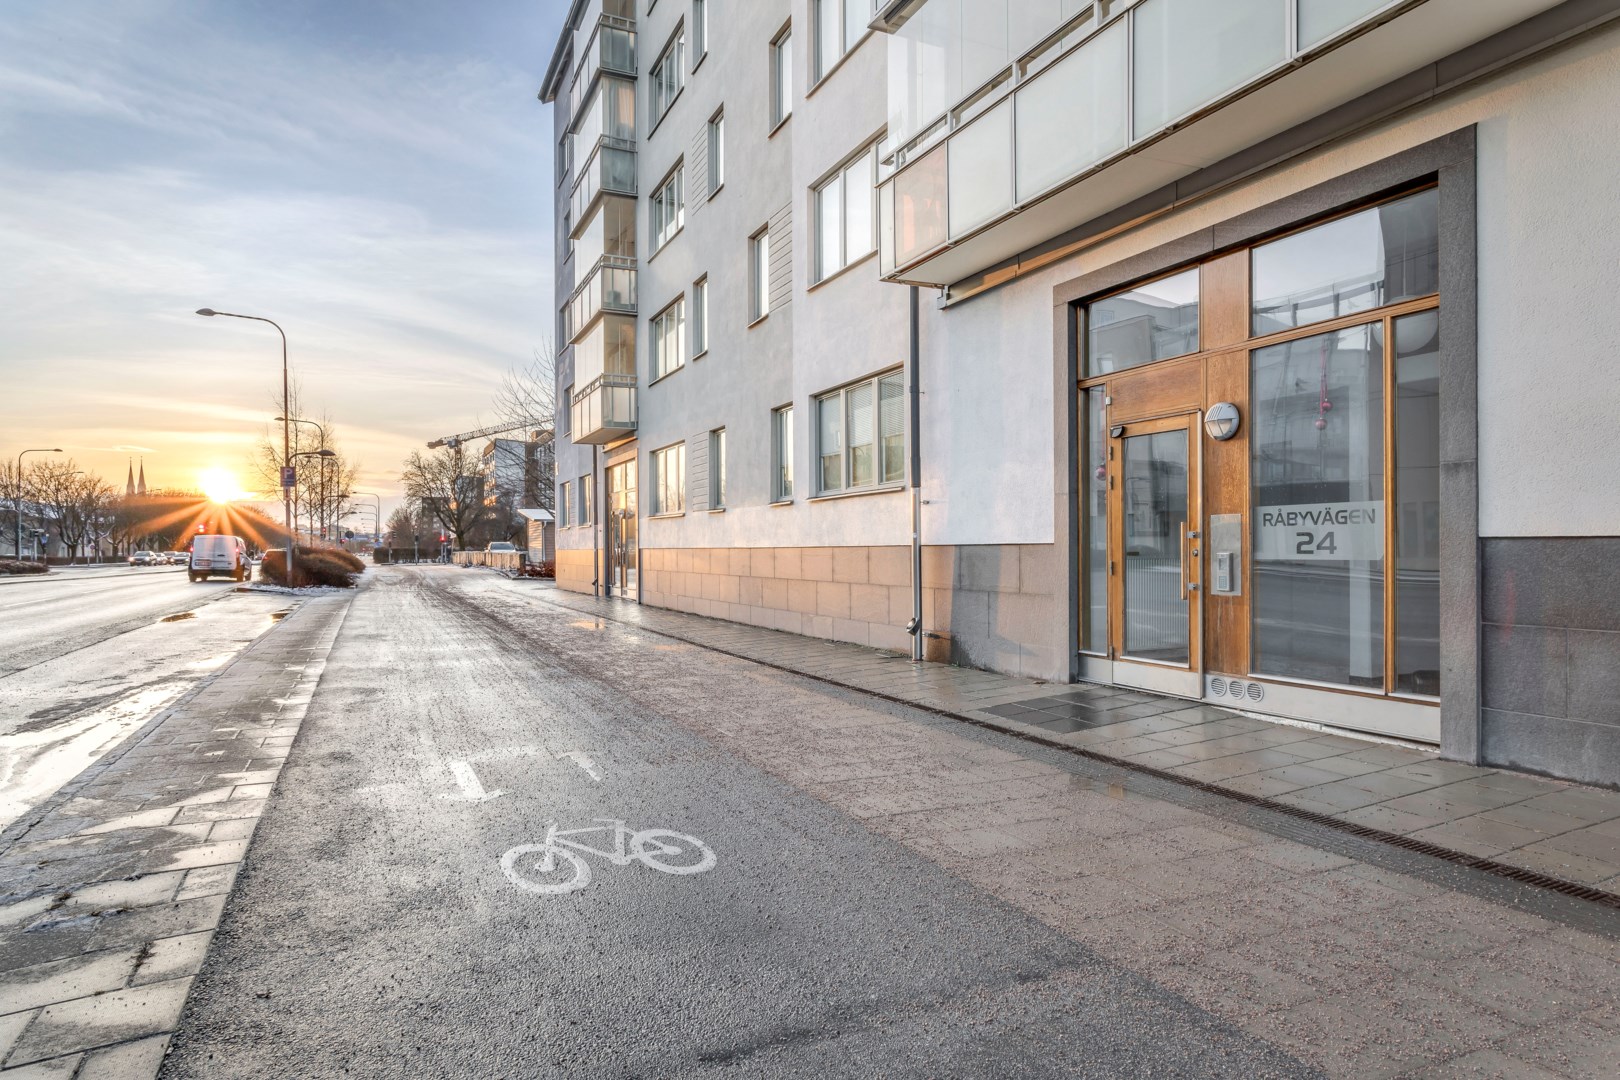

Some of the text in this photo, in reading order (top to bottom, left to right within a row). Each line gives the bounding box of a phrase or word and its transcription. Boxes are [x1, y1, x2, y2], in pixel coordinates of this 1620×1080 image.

[284, 468, 293, 479] P
[1262, 507, 1376, 528] RÅBYVÄGEN
[1296, 532, 1338, 555] 24
